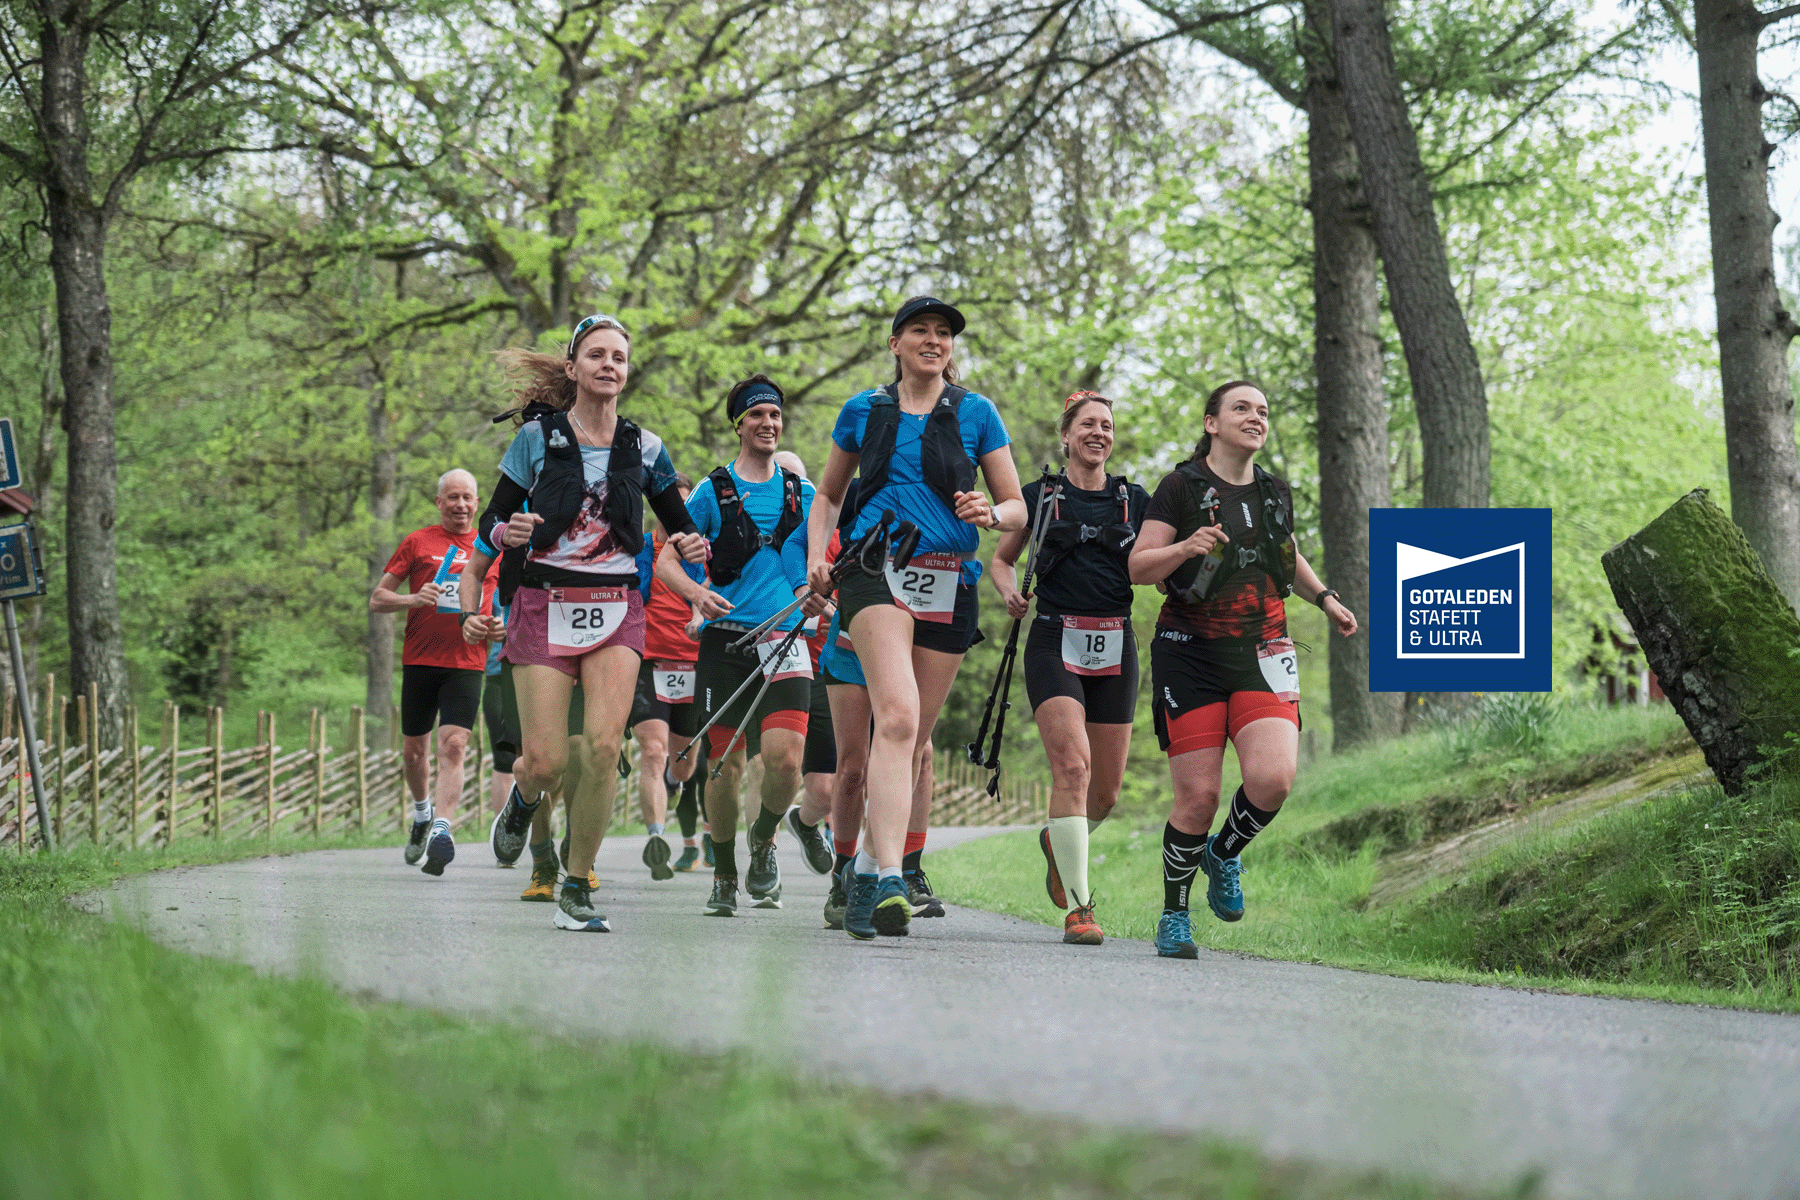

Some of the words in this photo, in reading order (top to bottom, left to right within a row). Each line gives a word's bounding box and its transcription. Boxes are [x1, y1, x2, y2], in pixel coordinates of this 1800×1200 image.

[925, 559, 945, 567] ULTRA
[902, 571, 935, 594] 22
[590, 592, 611, 600] ULTRA
[571, 607, 604, 629] 28
[1085, 633, 1105, 653] 18
[1281, 655, 1297, 675] 2
[666, 674, 685, 688] 24
